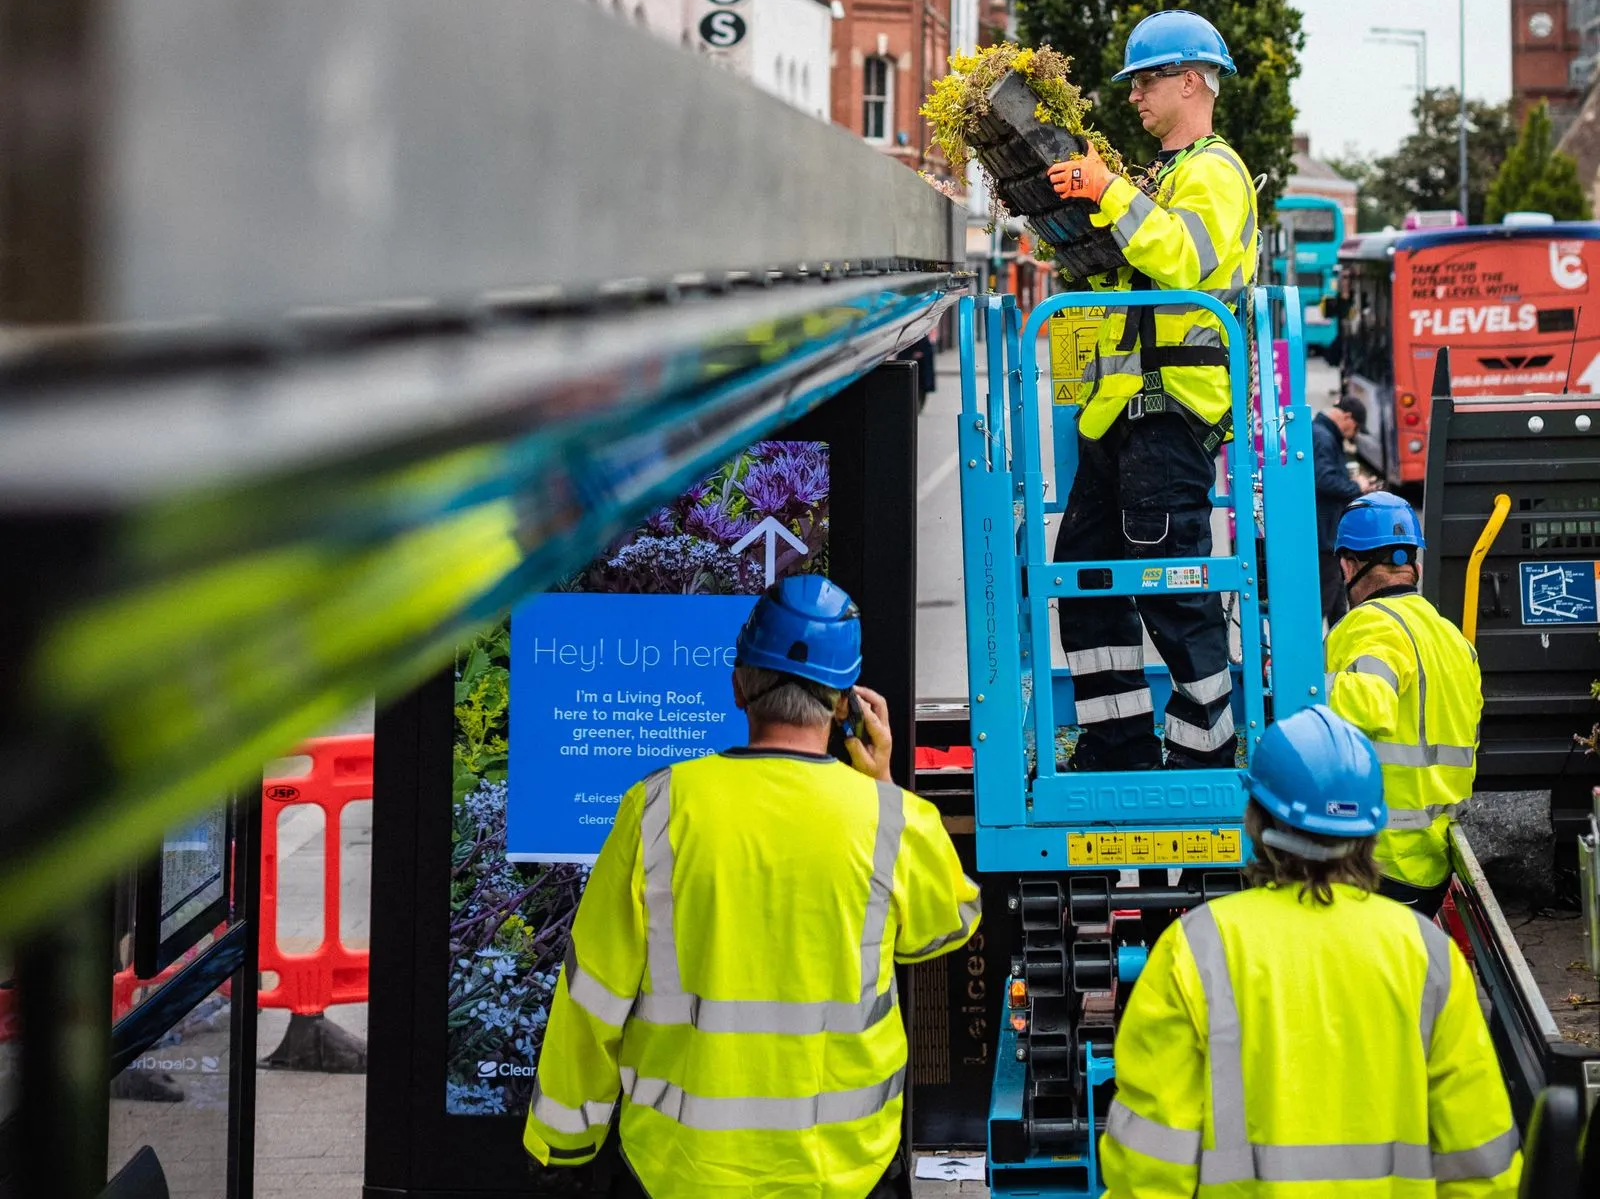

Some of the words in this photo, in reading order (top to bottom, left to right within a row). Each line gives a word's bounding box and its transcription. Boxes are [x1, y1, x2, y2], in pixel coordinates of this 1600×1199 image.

[1411, 263, 1440, 273] TAKE
[1445, 262, 1477, 272] YOUR
[1411, 275, 1456, 287] FUTURE
[1461, 274, 1477, 284] TO
[1481, 272, 1503, 282] THE
[1486, 283, 1519, 294] WITH
[983, 517, 998, 685] 0105600657
[535, 638, 604, 672] Hey!
[618, 639, 660, 672] Up
[673, 639, 737, 667] here
[576, 690, 598, 703] I'm
[602, 694, 612, 704] a
[617, 690, 661, 706] Living
[666, 691, 705, 706] Roof,
[554, 707, 588, 721] here
[593, 709, 607, 721] to
[612, 708, 653, 722] make
[659, 709, 726, 723] Leicester
[572, 728, 635, 741] greener,
[639, 726, 707, 740] healthier
[560, 743, 588, 757] and
[593, 746, 632, 757] more
[270, 788, 295, 799] JSP
[578, 814, 615, 825] clearc
[963, 931, 987, 1064] Leices
[499, 1063, 536, 1076] Clear
